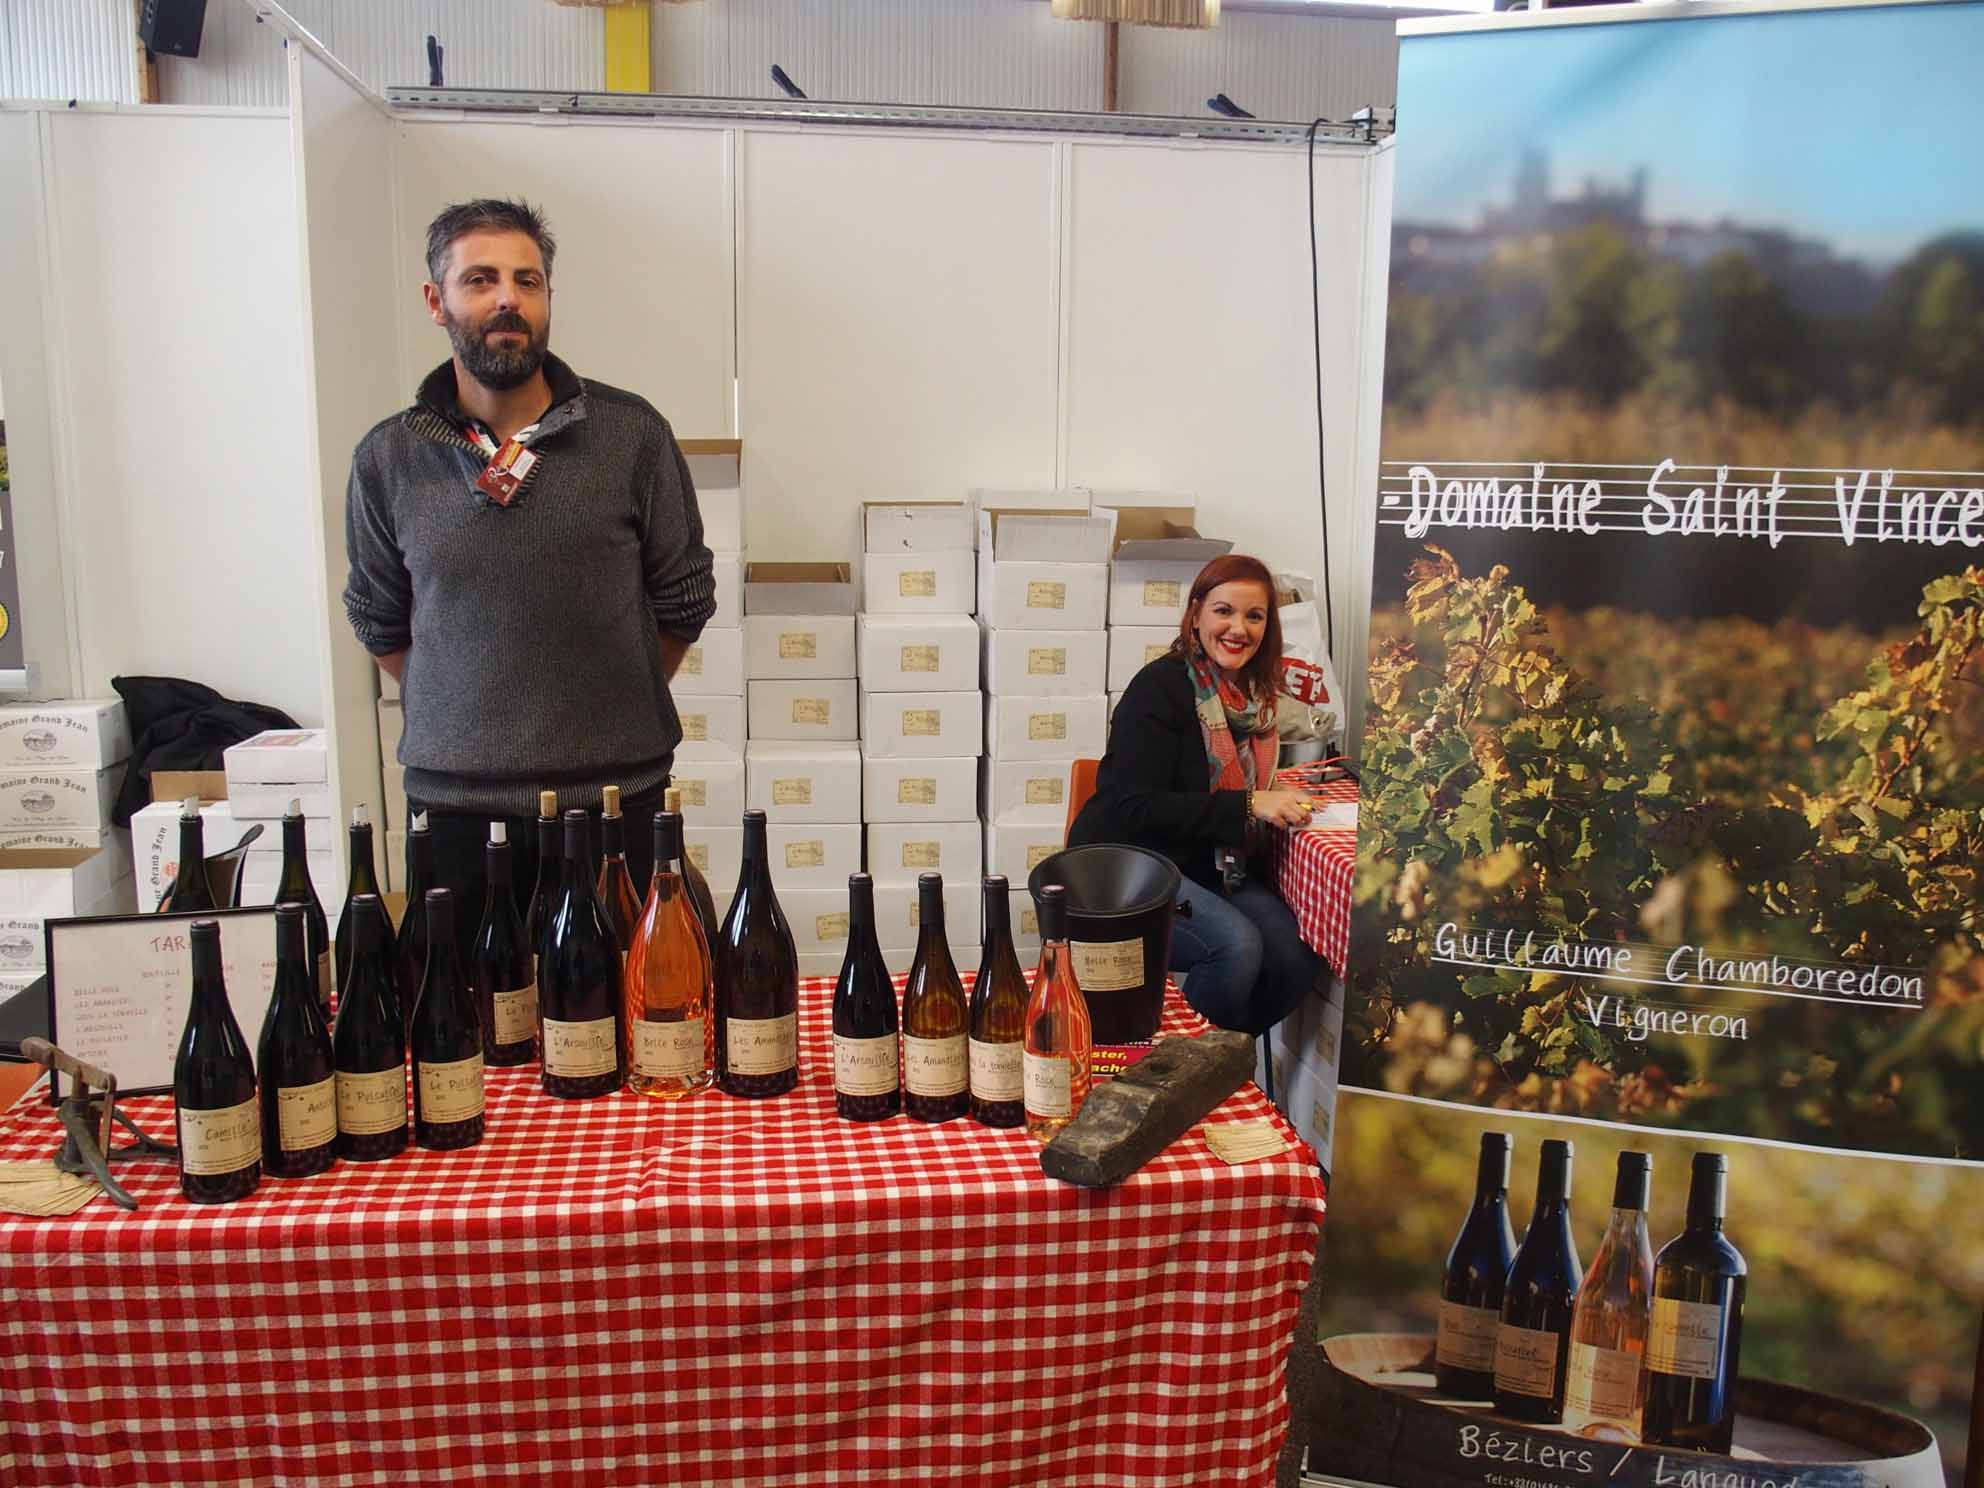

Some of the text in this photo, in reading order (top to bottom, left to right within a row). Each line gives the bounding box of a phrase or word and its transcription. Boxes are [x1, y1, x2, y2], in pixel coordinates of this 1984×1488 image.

[1404, 461, 1601, 538] Domaine
[1642, 458, 1787, 549] Saint
[32, 715, 62, 724] Grand
[30, 776, 60, 785] Grand
[150, 936, 192, 952] TAR
[1436, 922, 1923, 1000] Guillaume Chamboredon
[1584, 995, 1749, 1041] Vigneron
[1459, 1425, 1593, 1473] Béziers
[1609, 1448, 1633, 1477] /
